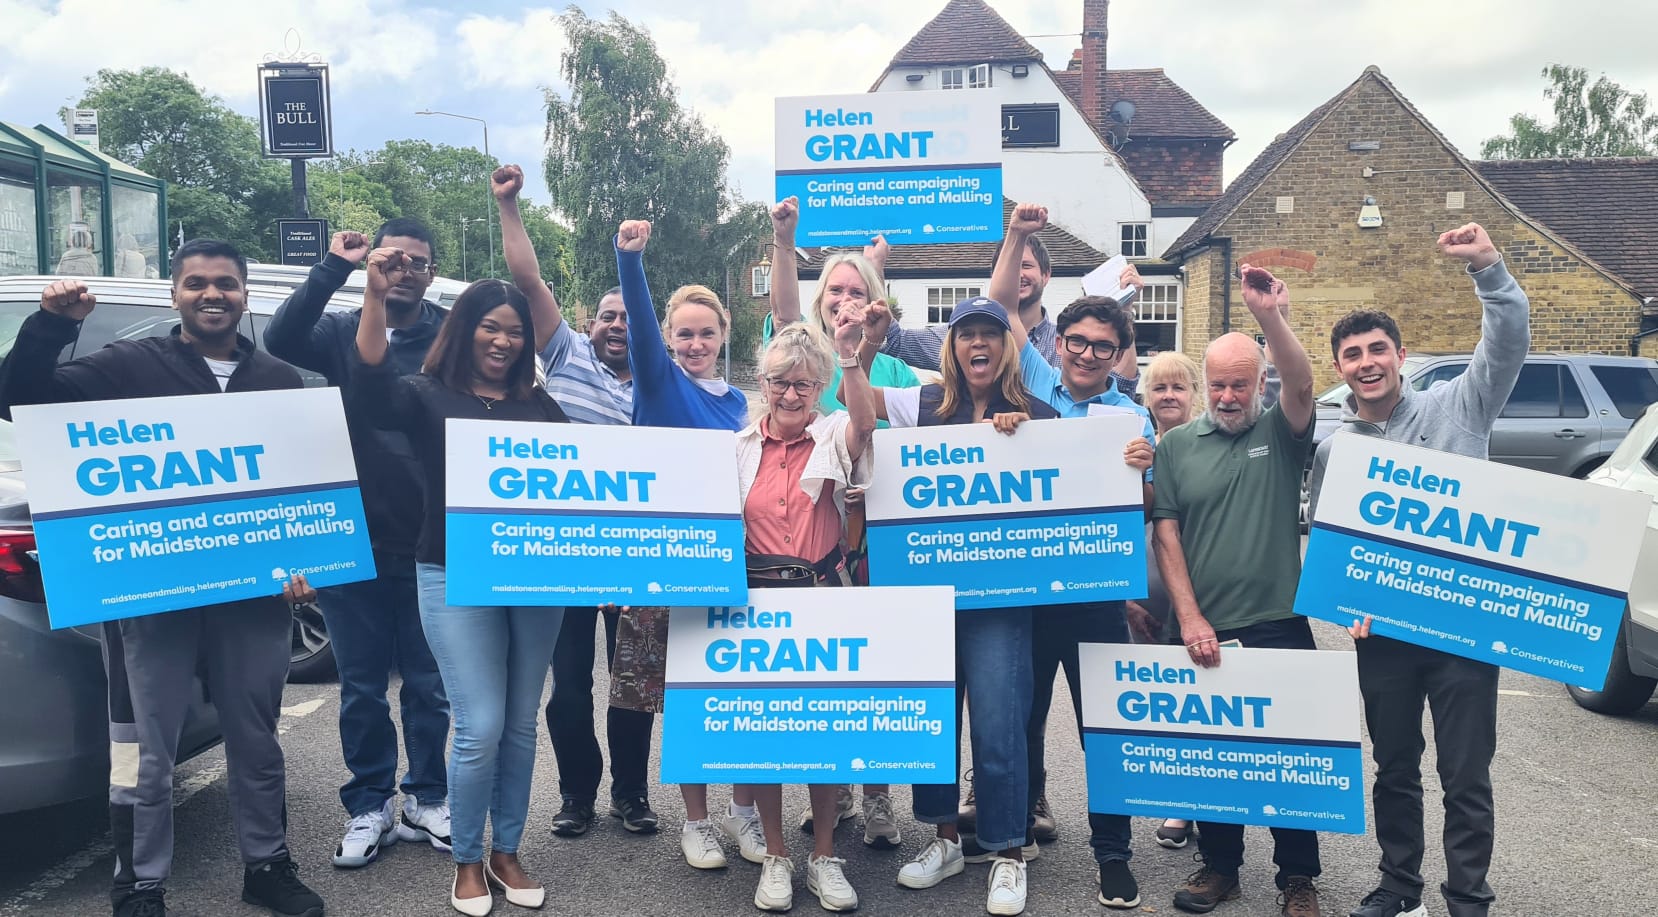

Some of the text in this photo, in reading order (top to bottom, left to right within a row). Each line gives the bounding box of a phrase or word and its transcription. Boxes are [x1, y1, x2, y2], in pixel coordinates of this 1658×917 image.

[276, 112, 317, 124] BULL
[284, 102, 306, 111] THE
[805, 108, 872, 127] Helen
[805, 130, 933, 162] GRANT
[807, 175, 980, 194] Caring and campaigning
[807, 189, 992, 207] for Maidstone and Malling
[66, 419, 174, 448] Helen
[488, 436, 578, 460] Helen
[900, 442, 984, 467] Helen
[76, 444, 264, 496] GRANT
[1367, 456, 1460, 497] Helen
[488, 467, 656, 502] GRANT
[902, 468, 1059, 509] GRANT
[89, 500, 336, 540] Caring and campaigning
[491, 521, 716, 544] Caring and campaigning
[1359, 491, 1540, 558] GRANT
[92, 517, 355, 563] for Maidstone and Malling
[906, 520, 1117, 547] Caring and campaigning
[491, 540, 732, 562] for Maidstone and Malling
[907, 538, 1133, 564] for Maidstone and Malling
[289, 560, 357, 576] Conservatives
[101, 576, 257, 604] maidstoneandmalling.helengrant.org
[491, 584, 633, 594] maidstoneandmalling.helengrant.org
[664, 584, 730, 592] Conservatives
[1066, 580, 1129, 590] Conservatives
[1350, 545, 1589, 617] Caring and campaigning
[1346, 563, 1602, 641] for Maidstone and Malling
[706, 605, 791, 629] Helen
[705, 637, 868, 672] GRANT
[1510, 646, 1584, 672] Conservatives
[1115, 660, 1195, 684] Helen
[704, 695, 926, 715] Caring and campaigning
[1116, 690, 1271, 728] GRANT
[703, 715, 942, 735] for Maidstone and Malling
[701, 761, 836, 771] maidstoneandmalling.helengrant.org
[868, 760, 936, 769] Conservatives
[1121, 742, 1333, 771] Caring and campaigning
[1122, 758, 1350, 790] for Maidstone and Malling
[1279, 807, 1345, 820] Conservatives
